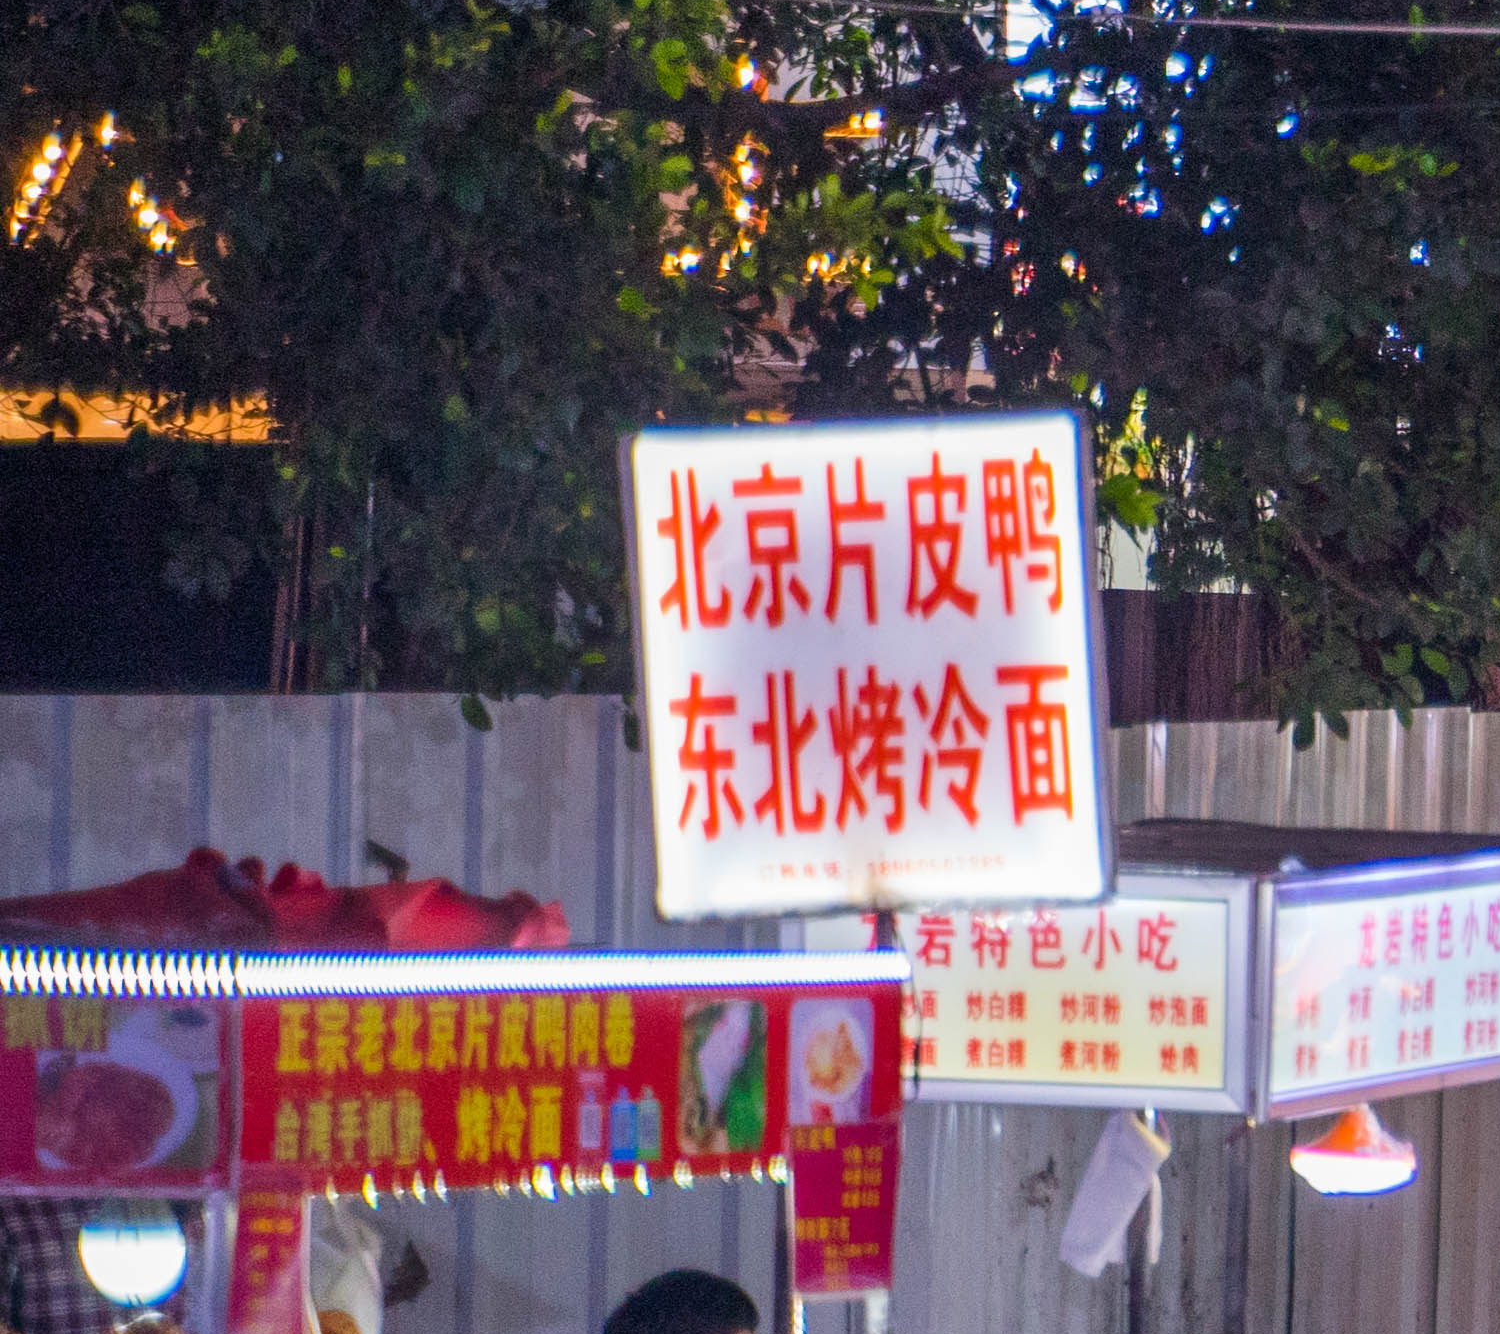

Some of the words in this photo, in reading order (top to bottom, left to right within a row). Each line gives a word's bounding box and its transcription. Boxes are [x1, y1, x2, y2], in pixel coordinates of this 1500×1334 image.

[657, 447, 1062, 631] 北京片皮鸭
[669, 663, 1074, 841] 东北烤冷面
[1060, 993, 1122, 1026] 炒河粉
[1060, 1040, 1121, 1072] 煮河粉
